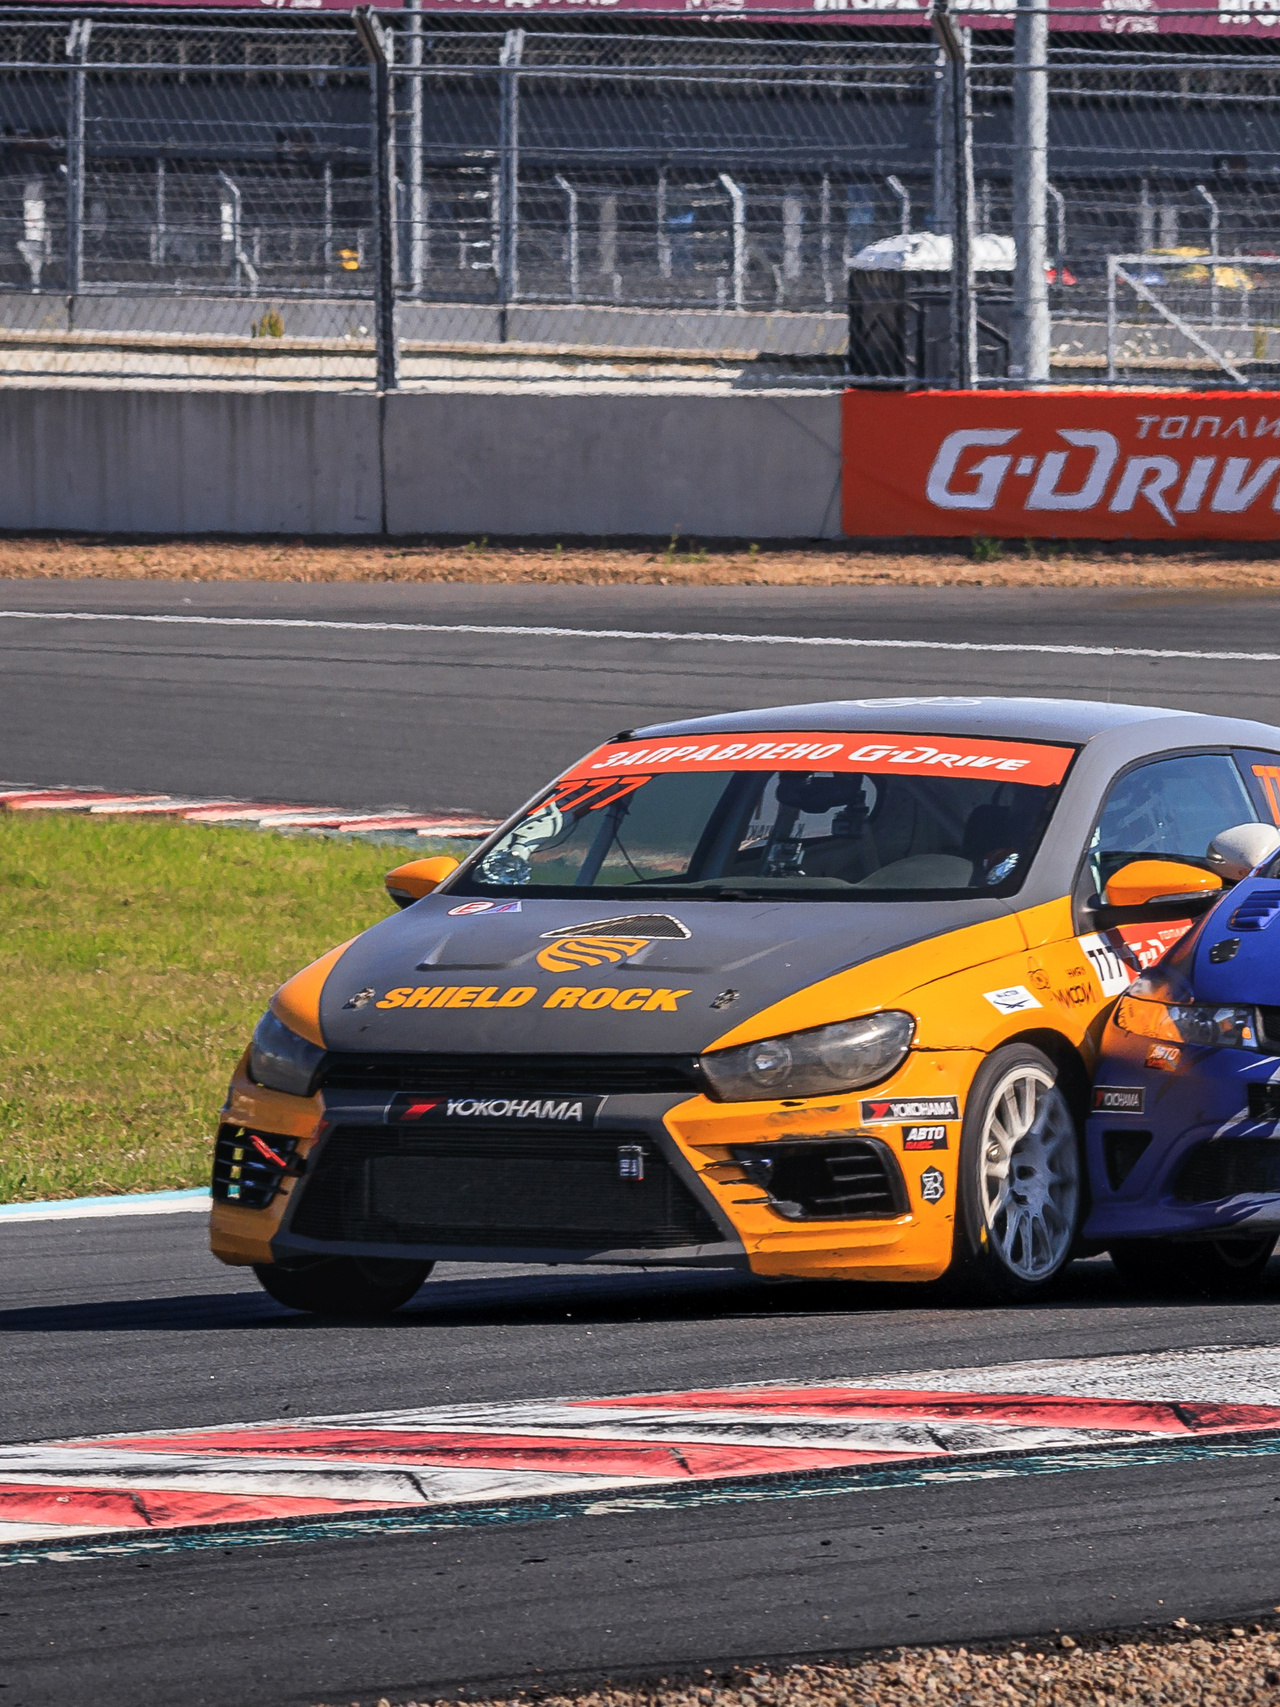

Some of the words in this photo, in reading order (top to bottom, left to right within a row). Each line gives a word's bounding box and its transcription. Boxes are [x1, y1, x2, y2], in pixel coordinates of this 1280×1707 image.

[591, 743, 843, 769] ЗАПРАВЛЕНО
[527, 775, 652, 815] 777
[376, 986, 538, 1009] SHIELD
[543, 986, 693, 1012] ROCK
[446, 1099, 582, 1121] YOKOHAMA
[889, 1102, 955, 1117] YOKOHAMA
[906, 1126, 945, 1141] АВТО
